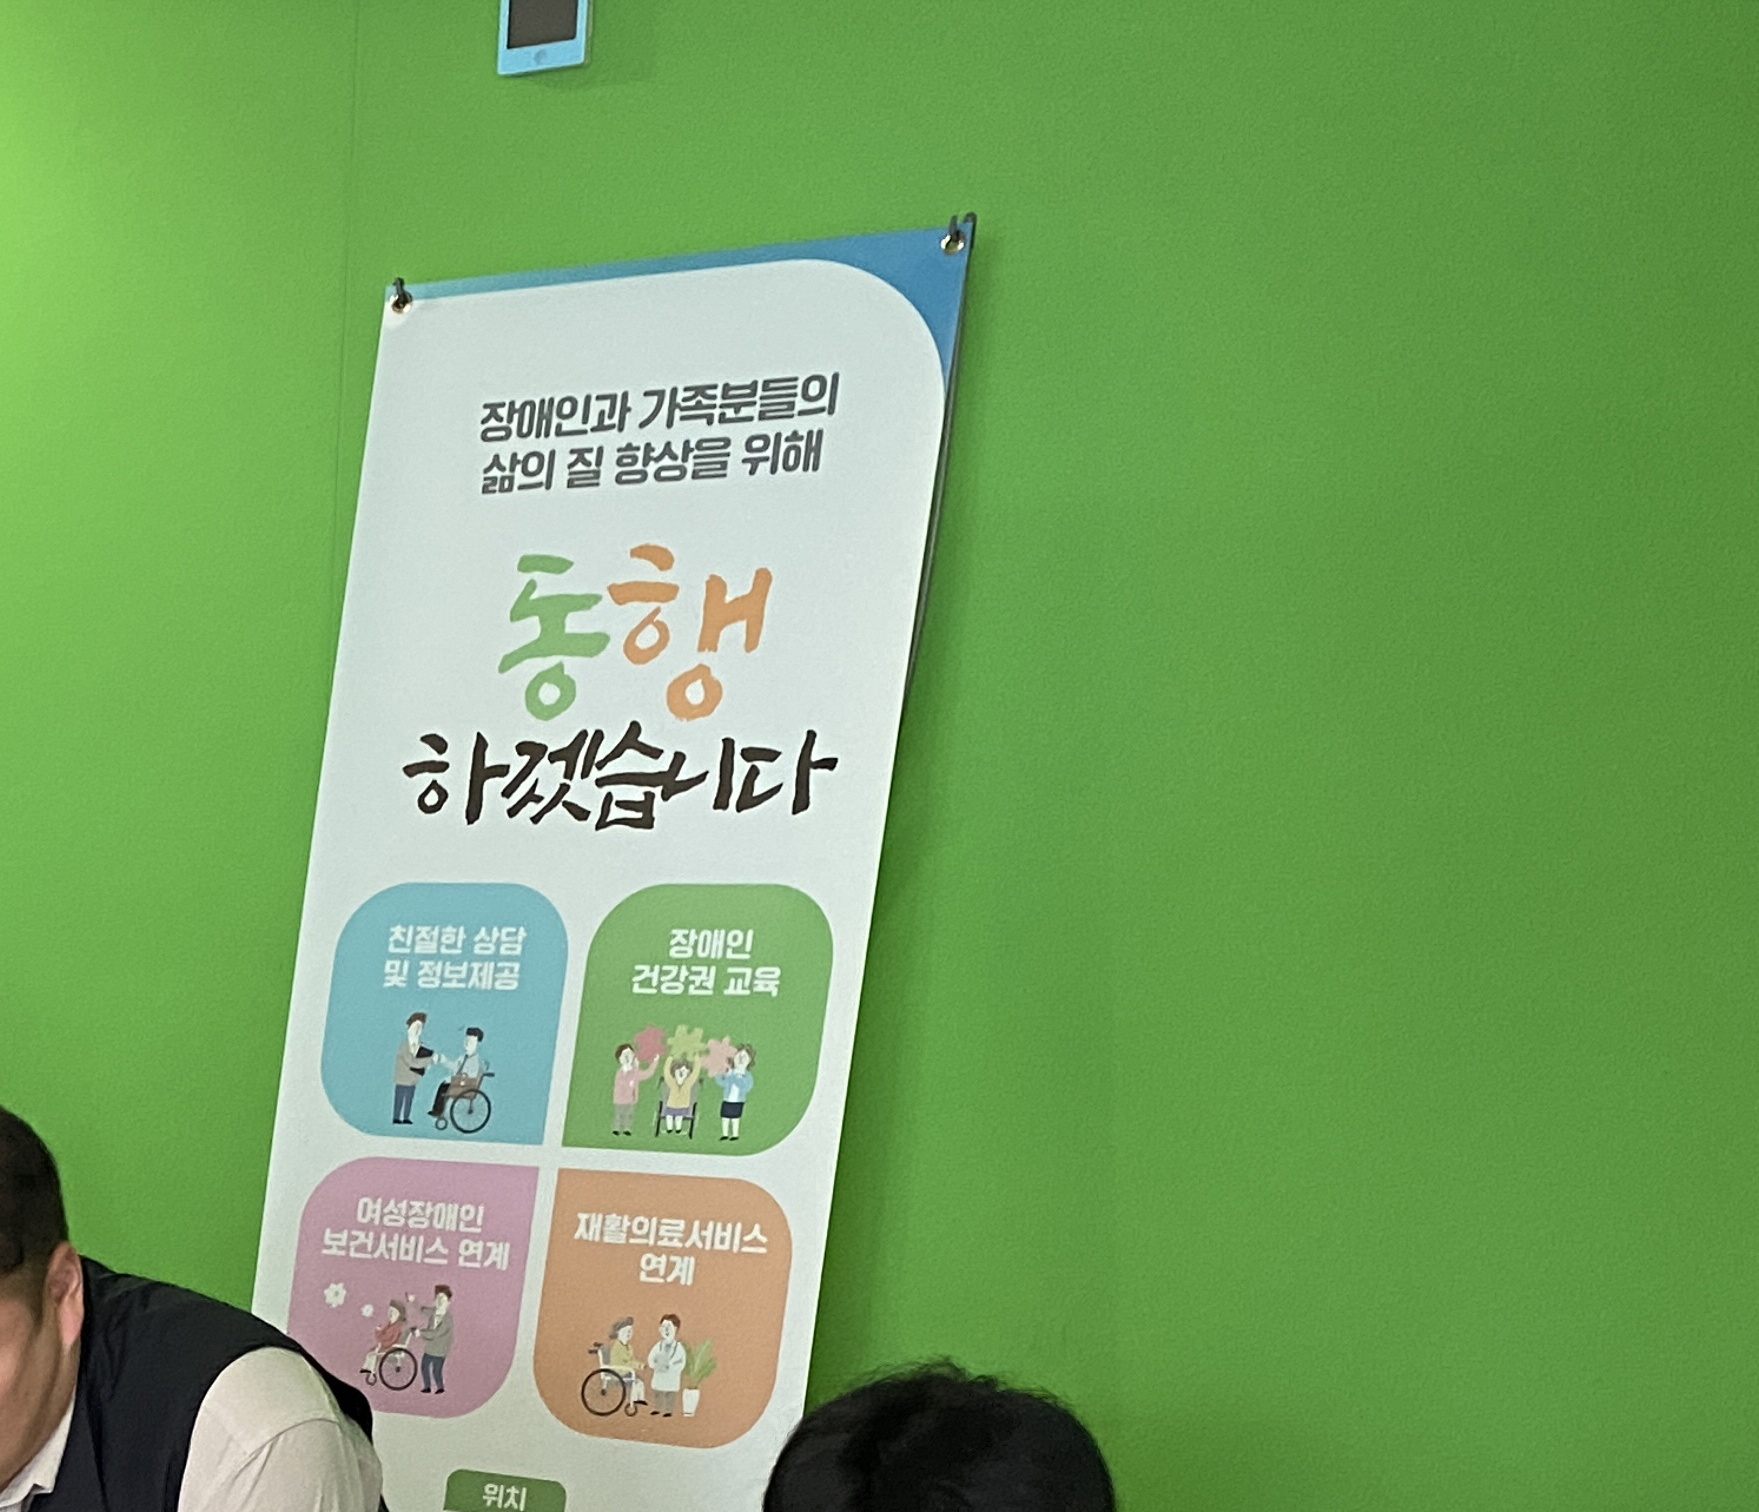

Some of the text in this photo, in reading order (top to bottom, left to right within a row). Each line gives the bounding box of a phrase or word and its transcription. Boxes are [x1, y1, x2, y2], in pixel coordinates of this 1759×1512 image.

[480, 372, 840, 443] 장애인과 가족분들의
[481, 428, 824, 495] 삶의 질 향상을 위해
[498, 543, 773, 722] 동행
[402, 720, 839, 831] 하겠습니다
[387, 923, 527, 957] 친절한 상담
[668, 928, 755, 961] 장애인
[382, 958, 521, 992] 및 정보제공
[630, 963, 782, 998] 건강권 교육
[355, 1197, 485, 1235] 여성장애인
[574, 1212, 769, 1256] 재활의료서비스
[320, 1228, 512, 1272] 보건서비스 연계
[639, 1253, 695, 1287] 연계
[482, 1482, 527, 1512] 위치
